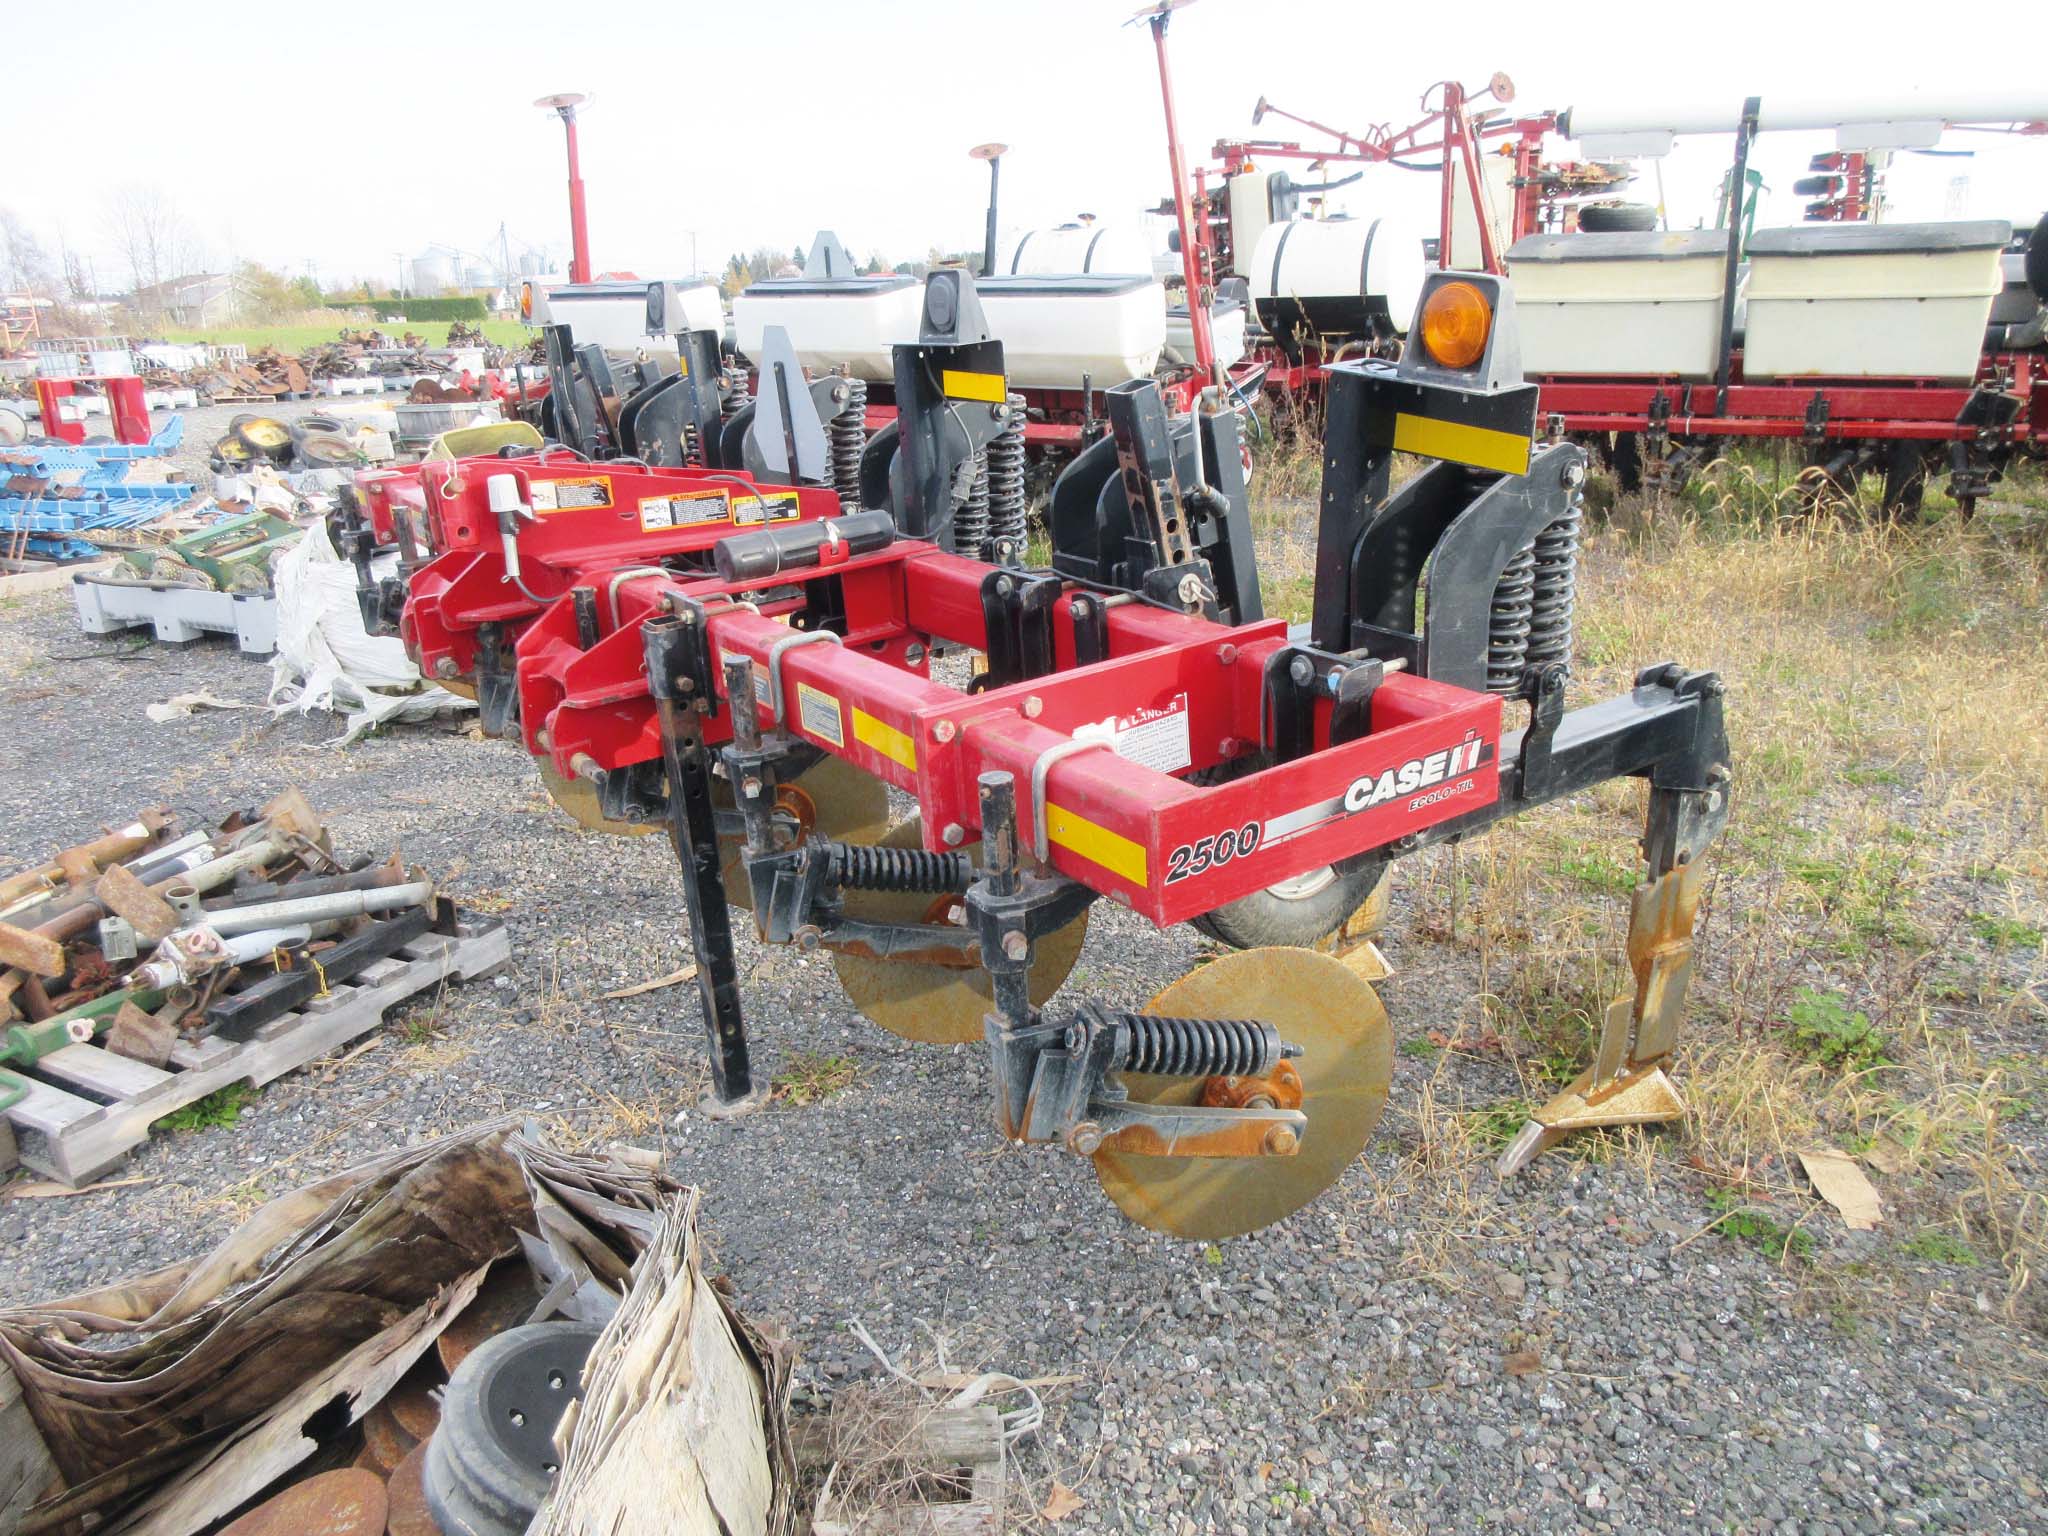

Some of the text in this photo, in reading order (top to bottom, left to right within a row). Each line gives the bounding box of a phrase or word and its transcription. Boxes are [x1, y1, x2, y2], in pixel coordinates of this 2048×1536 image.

[1344, 750, 1448, 812] CASE
[1408, 778, 1475, 813] ECOLO-TIL
[1164, 821, 1260, 886] 2500
